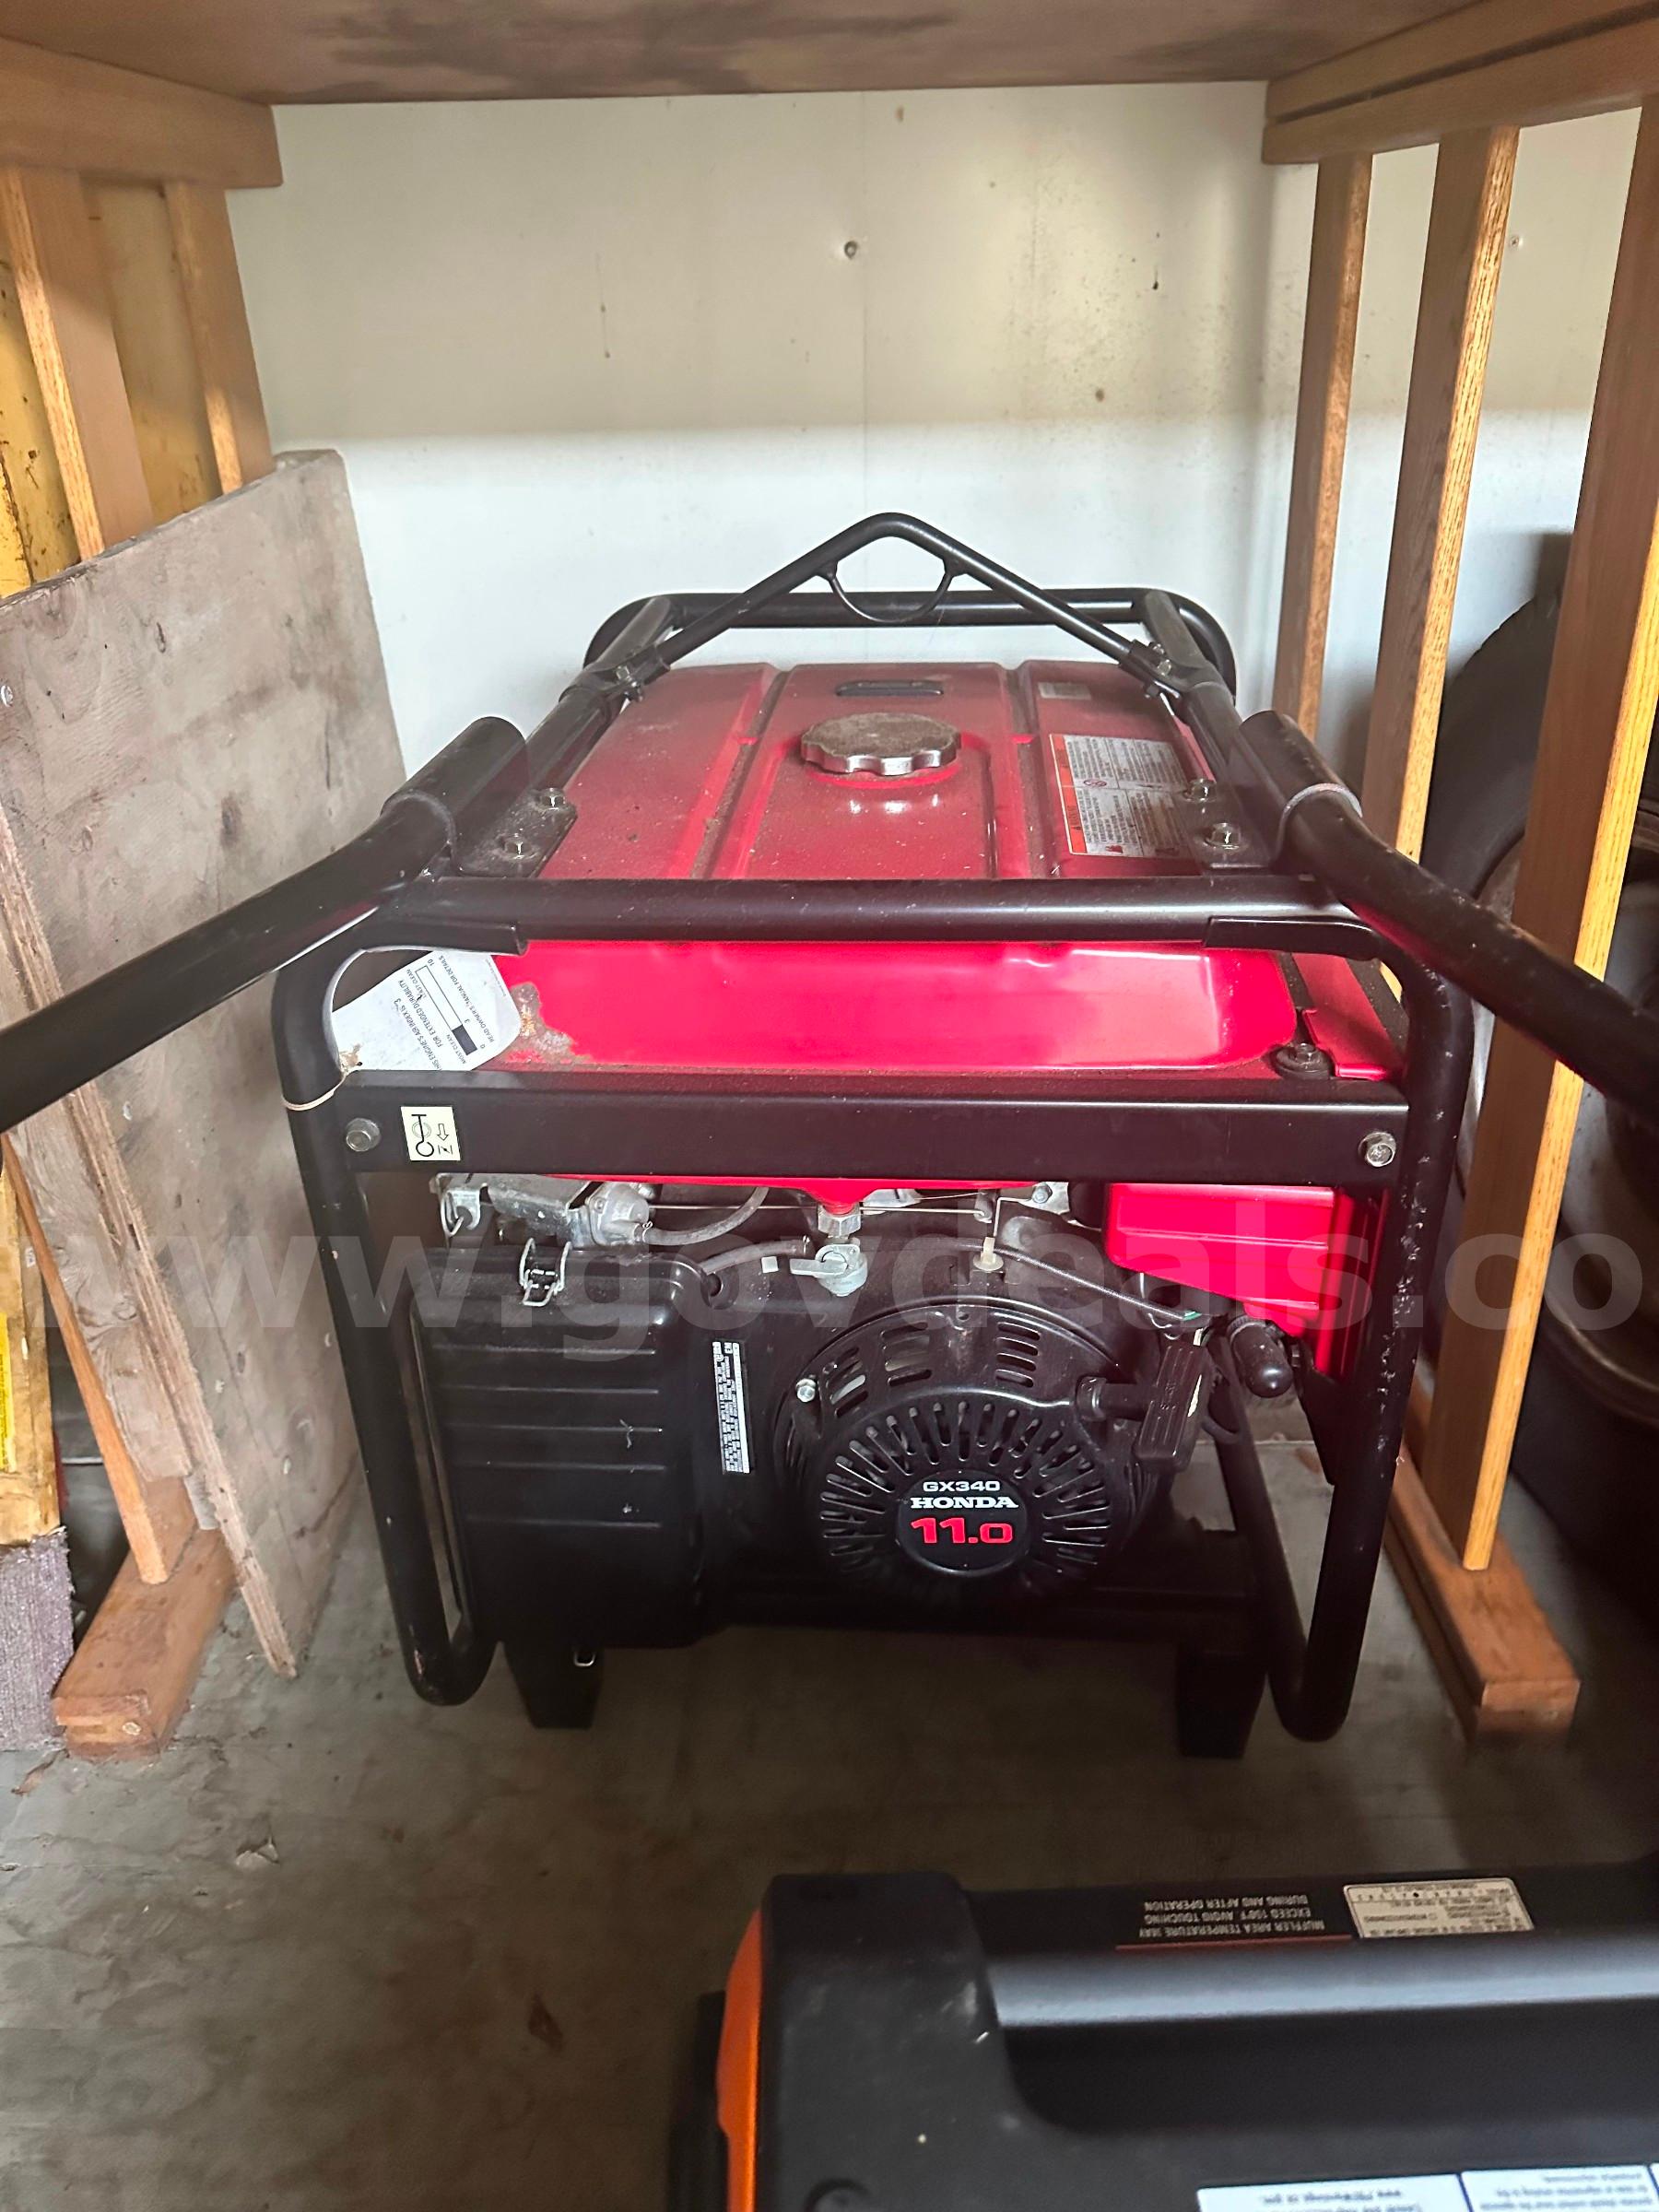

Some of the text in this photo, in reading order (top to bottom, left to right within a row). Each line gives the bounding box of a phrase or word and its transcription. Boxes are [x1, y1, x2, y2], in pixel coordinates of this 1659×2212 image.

[439, 956, 453, 975] DETAILS
[451, 975, 459, 985] FOR
[398, 979, 442, 1047] FOR EXTENDED DURABILITY
[447, 1034, 458, 1050] CLEAN
[923, 1480, 1001, 1492] GX340
[911, 1496, 1019, 1509] HONDA
[911, 1517, 1013, 1544] 11.0
[1144, 1900, 1204, 1912] OPERATION
[1206, 1898, 1239, 1909] AFTER
[1144, 1913, 1200, 1924] TOUCHING
[1165, 1924, 1241, 1936] TEMPERATURE
[1245, 1923, 1272, 1934] AREA
